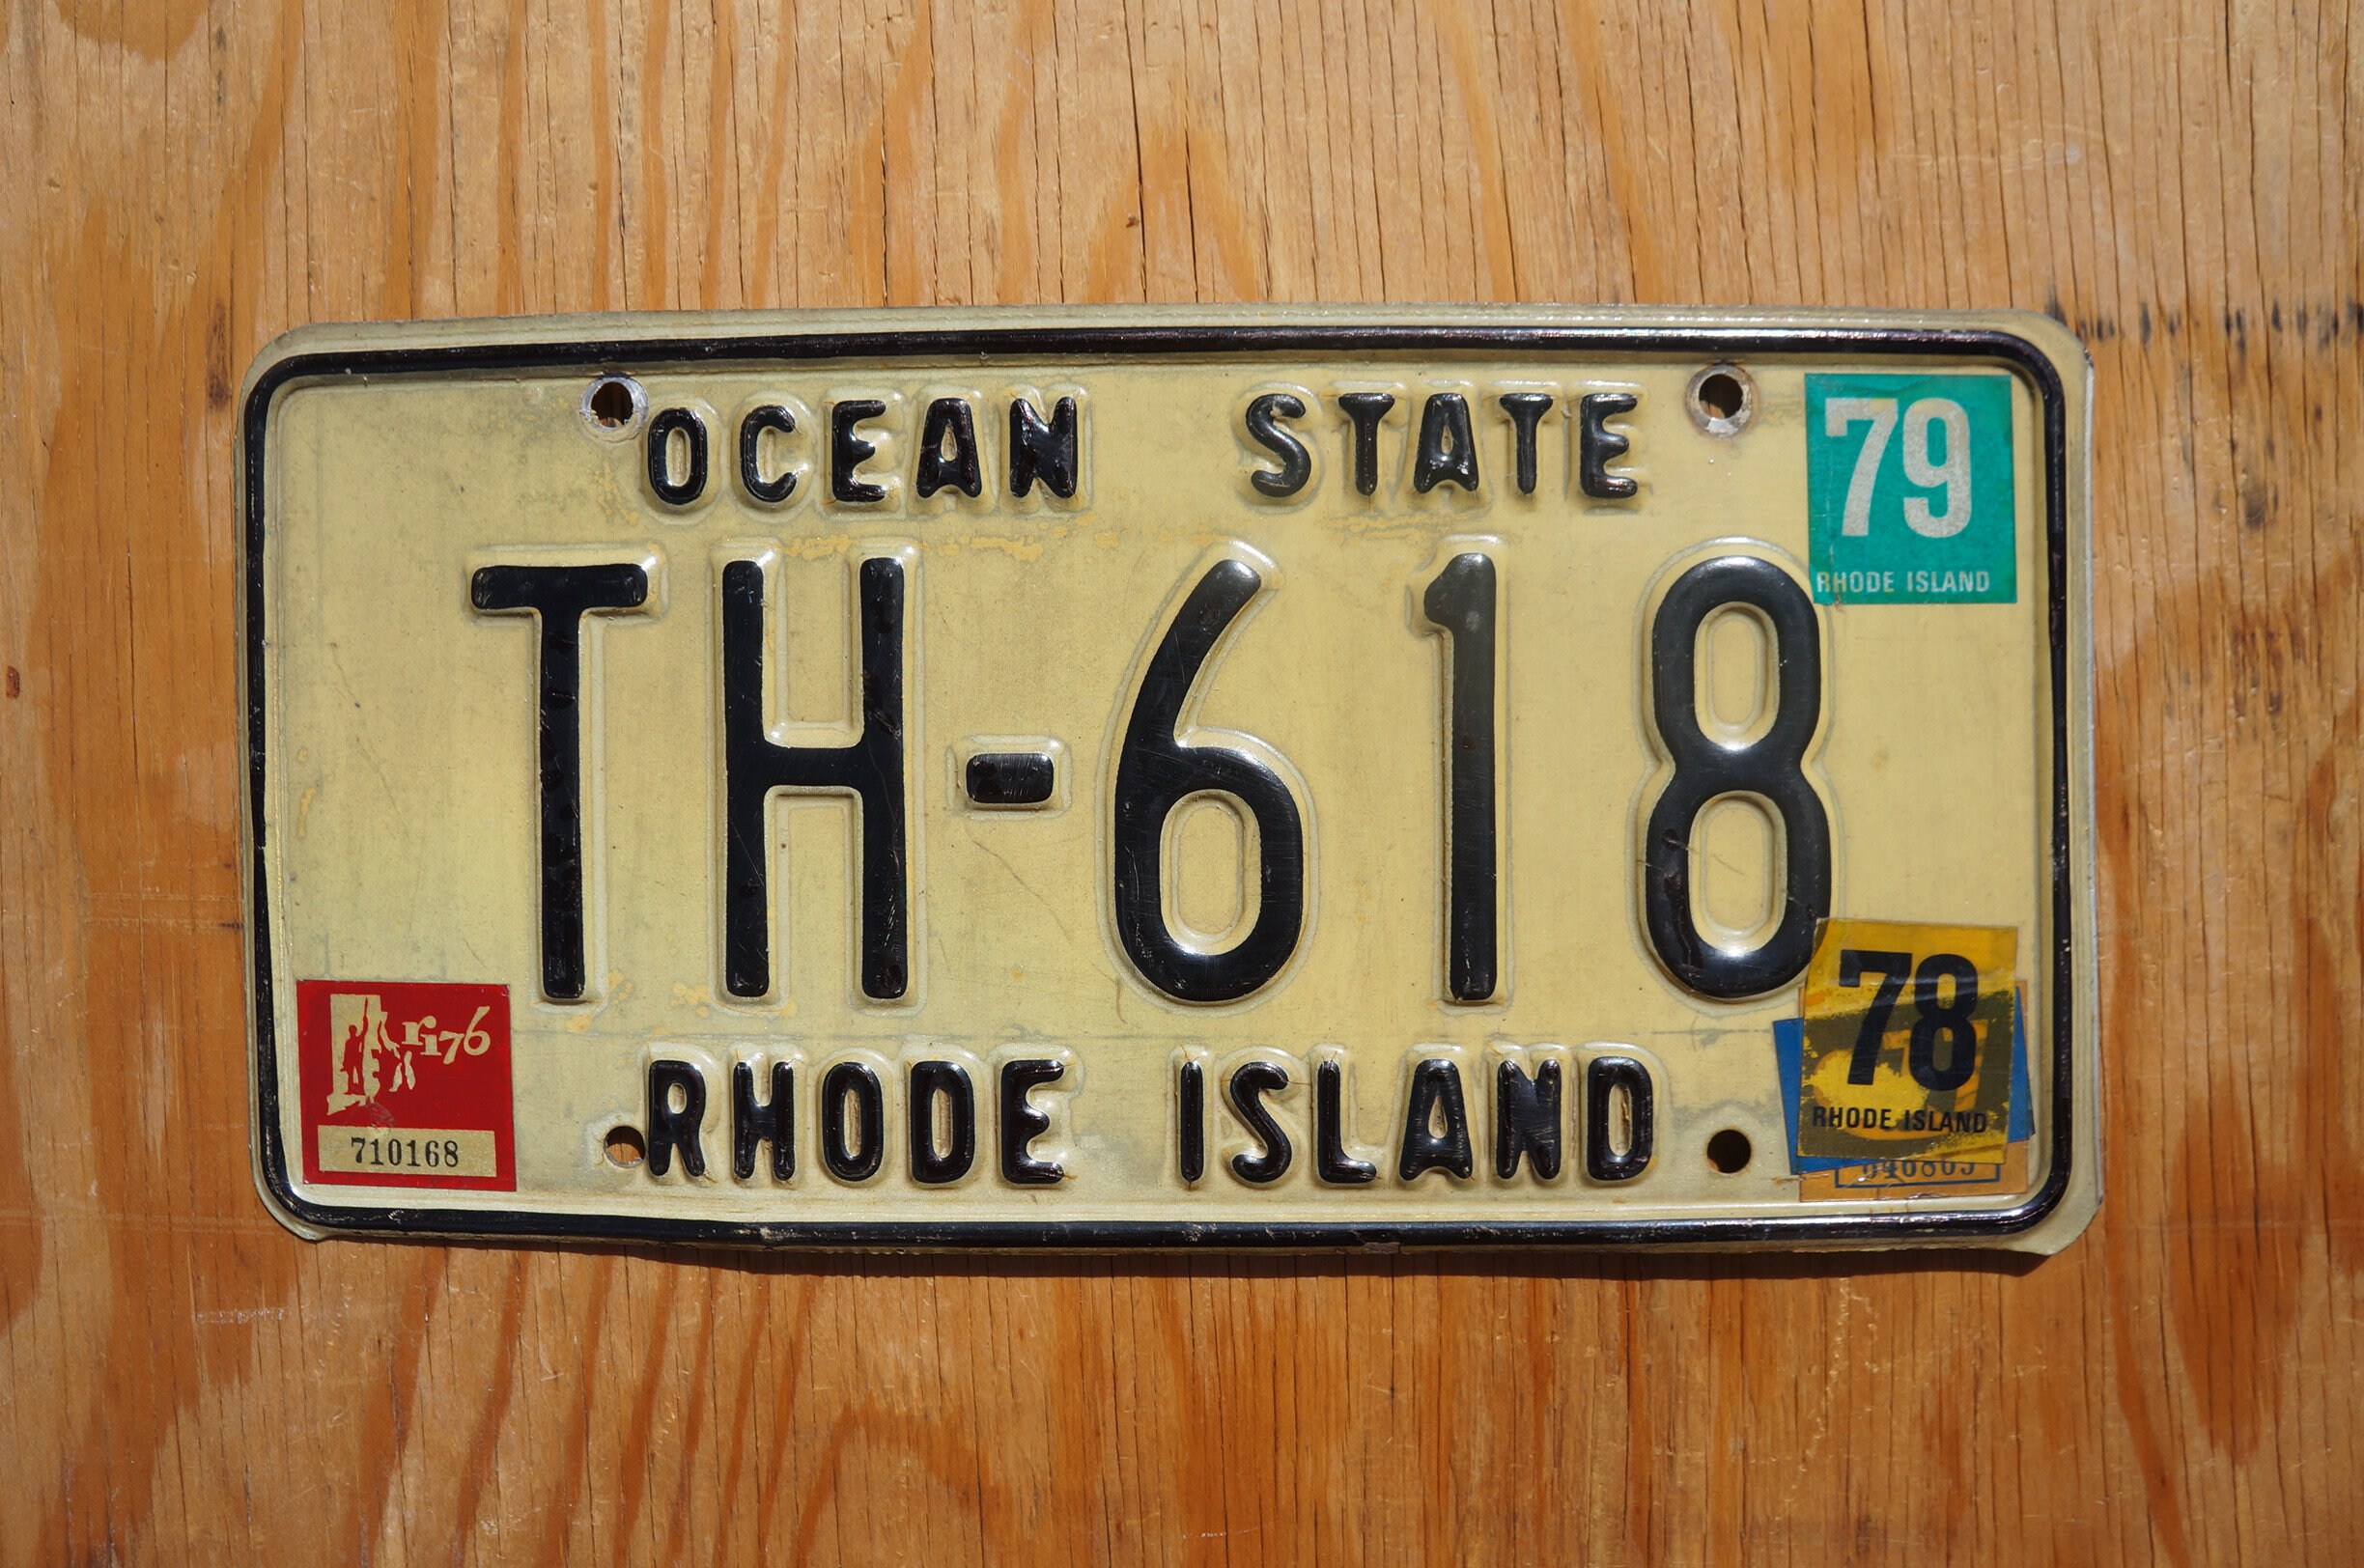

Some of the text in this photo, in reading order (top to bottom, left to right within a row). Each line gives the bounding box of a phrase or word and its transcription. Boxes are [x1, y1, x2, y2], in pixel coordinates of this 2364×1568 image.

[648, 392, 1639, 505] OCEAN STATE
[1825, 397, 1973, 539] 79
[1816, 571, 1990, 593] RHODE ISLAND
[471, 551, 1833, 1002] TH-618
[1839, 949, 1979, 1091] 78
[351, 1136, 460, 1167] 710168
[649, 1056, 1654, 1184] RHODE ISLAND
[1812, 1106, 1988, 1134] RHODE ISLAND
